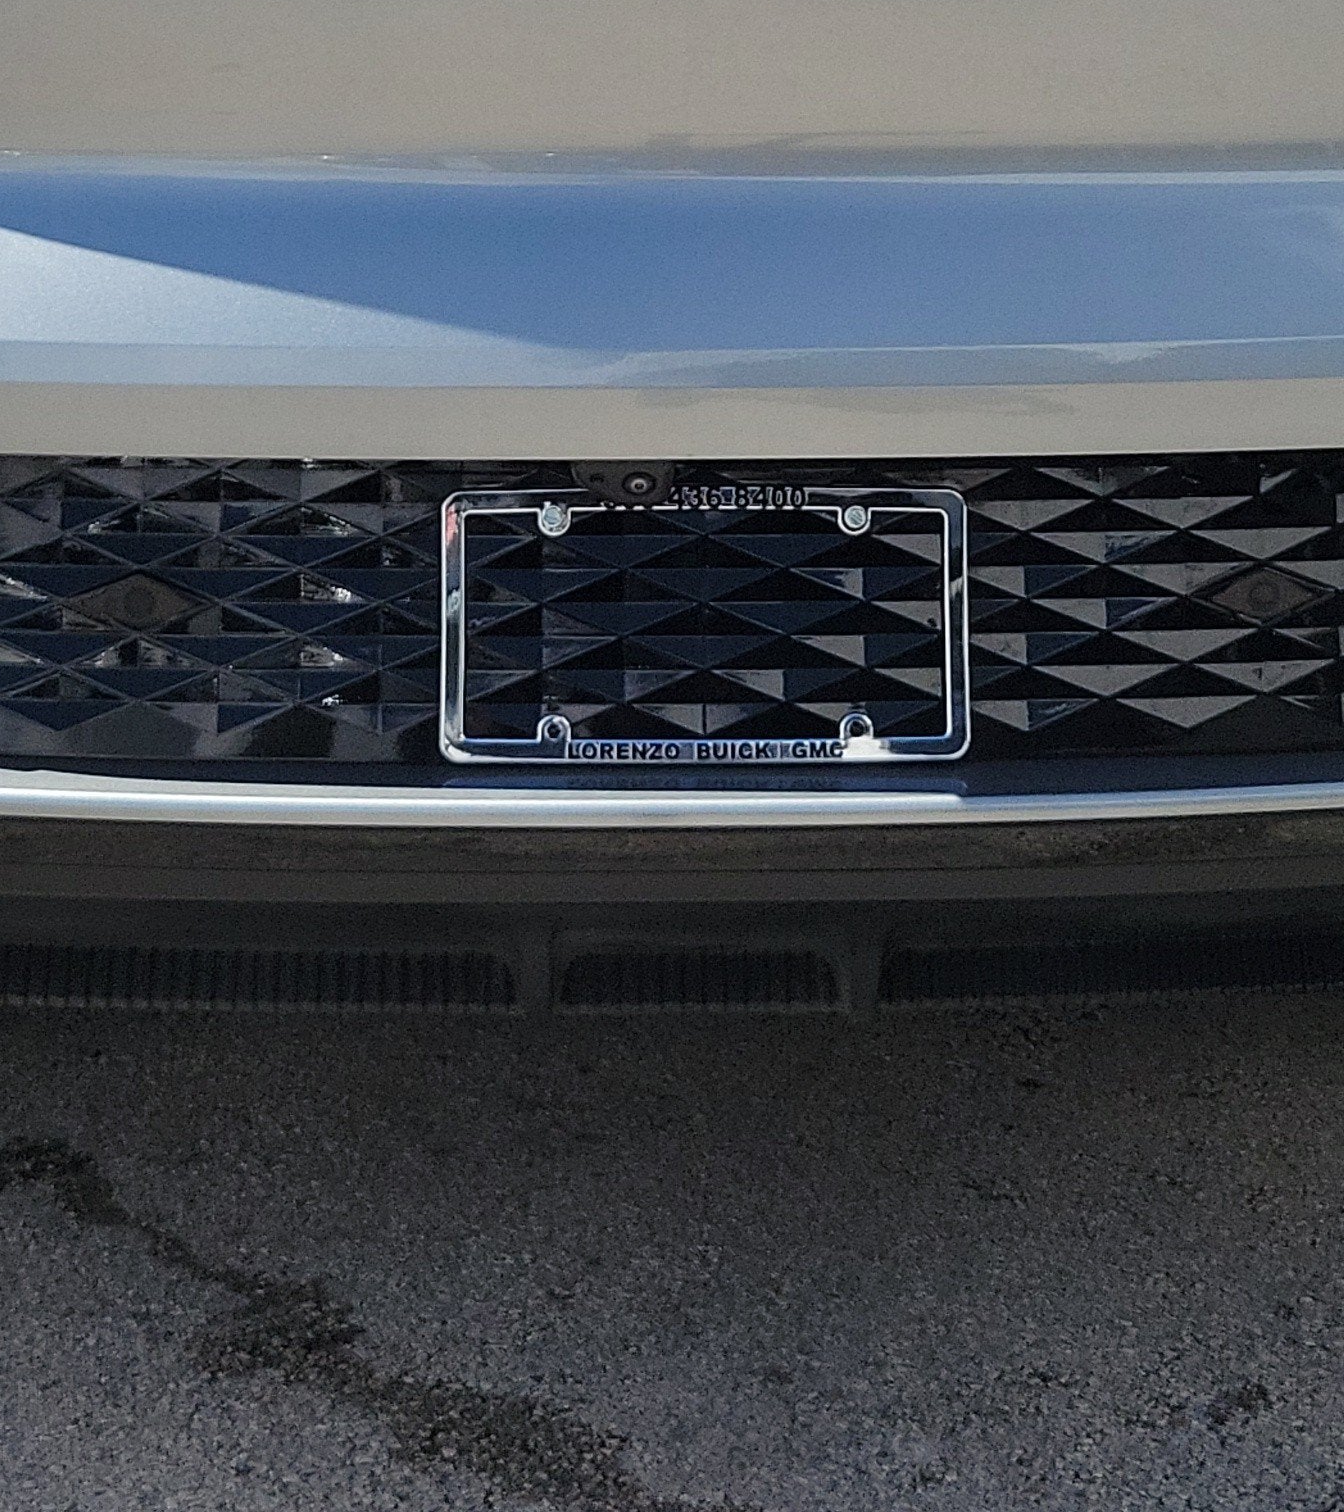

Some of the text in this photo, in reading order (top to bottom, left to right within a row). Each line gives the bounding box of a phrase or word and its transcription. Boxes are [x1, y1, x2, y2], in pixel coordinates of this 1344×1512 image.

[567, 741, 845, 760] LORENZO BUICK GMC
